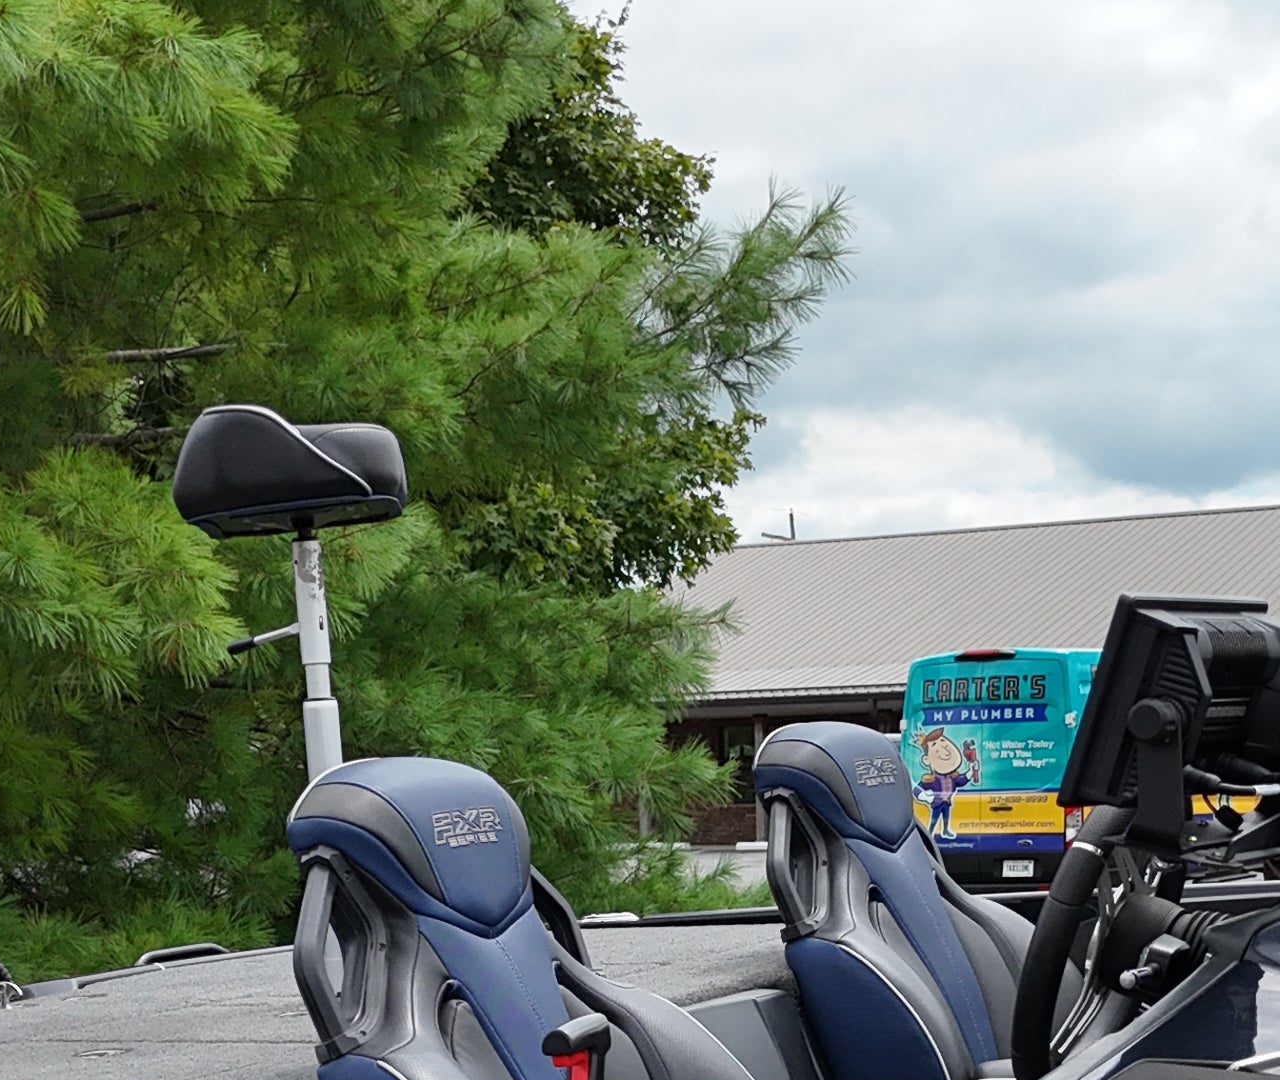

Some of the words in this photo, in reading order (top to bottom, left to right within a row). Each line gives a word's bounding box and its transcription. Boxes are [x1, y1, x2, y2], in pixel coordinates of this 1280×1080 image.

[923, 675, 1046, 703] CARTER'S
[934, 711, 953, 721] MY
[961, 708, 1035, 720] PLUMBER
[1027, 740, 1054, 749] Today
[432, 807, 502, 844] FXR
[448, 832, 498, 848] SERIES
